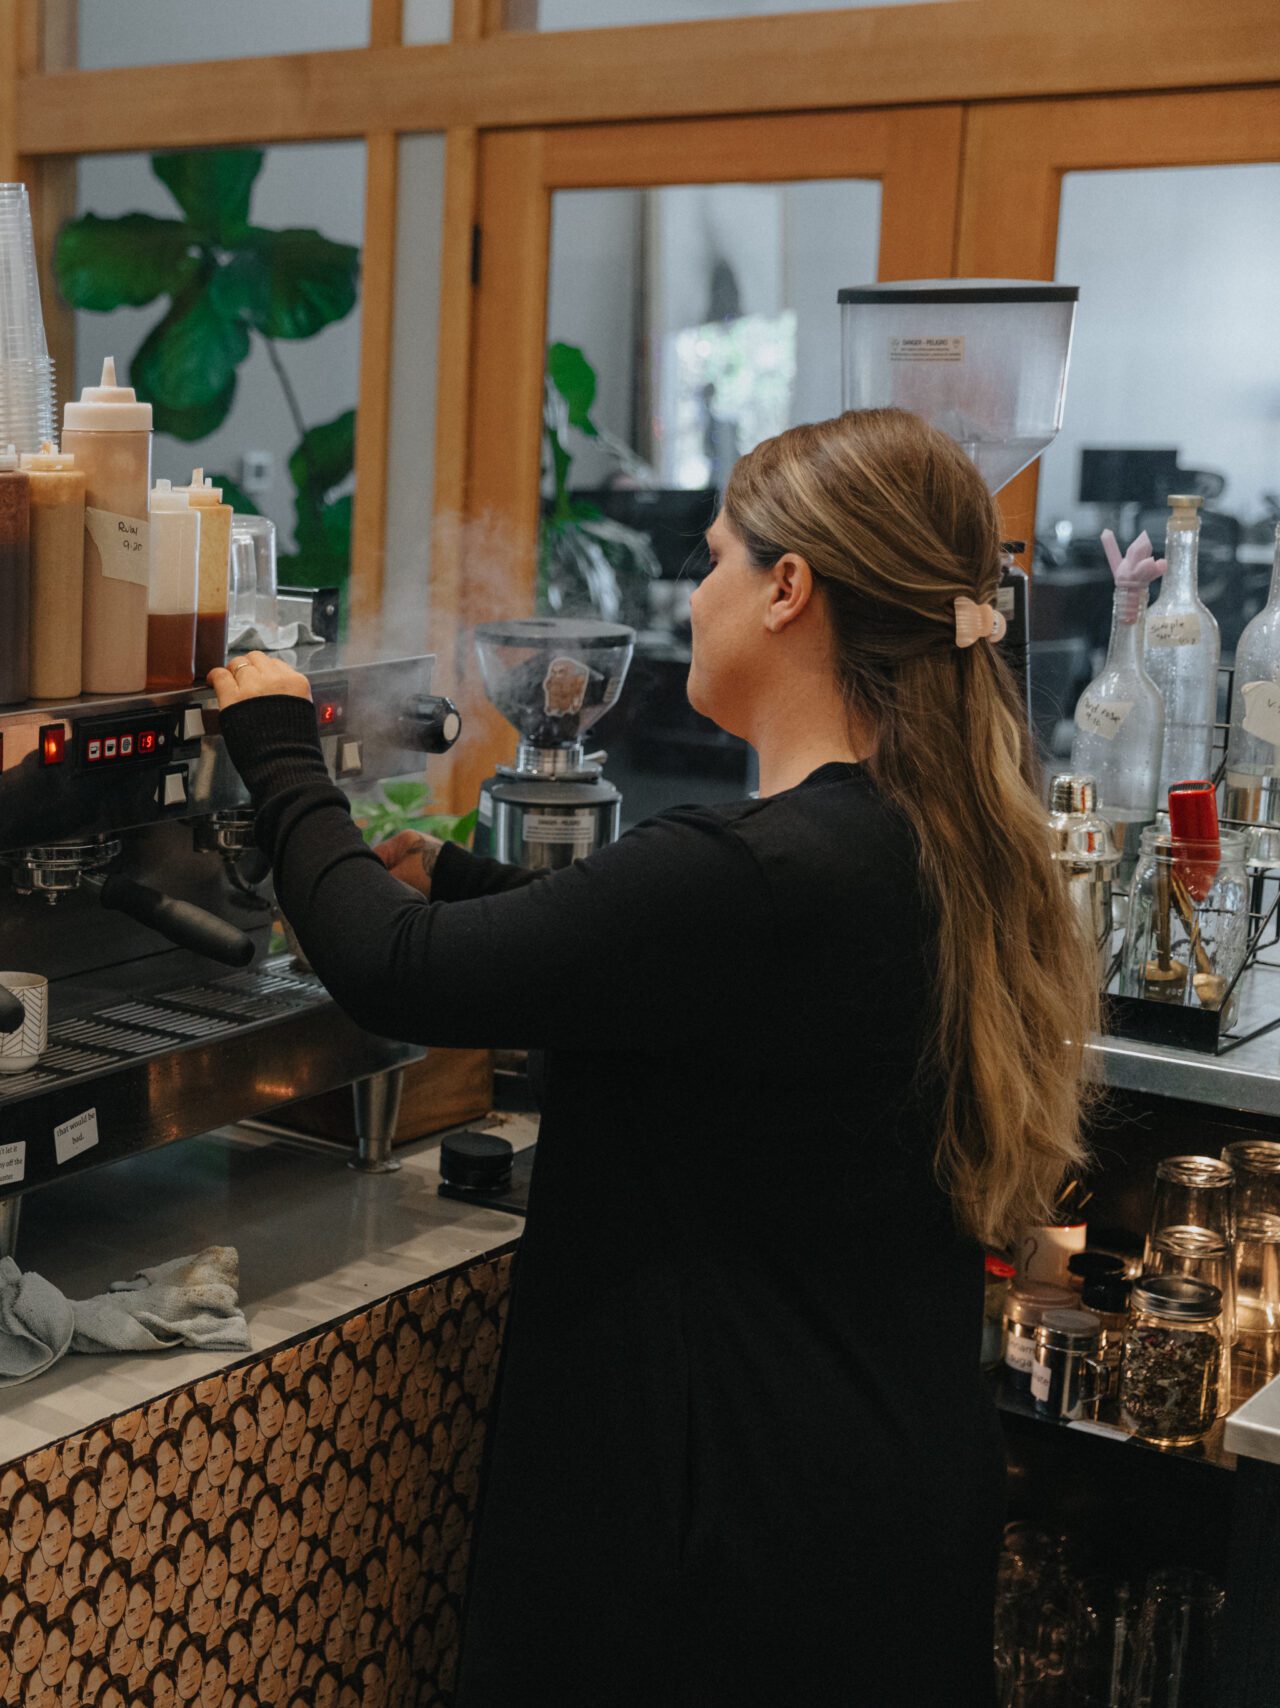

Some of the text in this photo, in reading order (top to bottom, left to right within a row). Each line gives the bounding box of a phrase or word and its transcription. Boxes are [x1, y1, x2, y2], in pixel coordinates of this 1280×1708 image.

[56, 1112, 96, 1138] that would be
[14, 1157, 23, 1166] the
